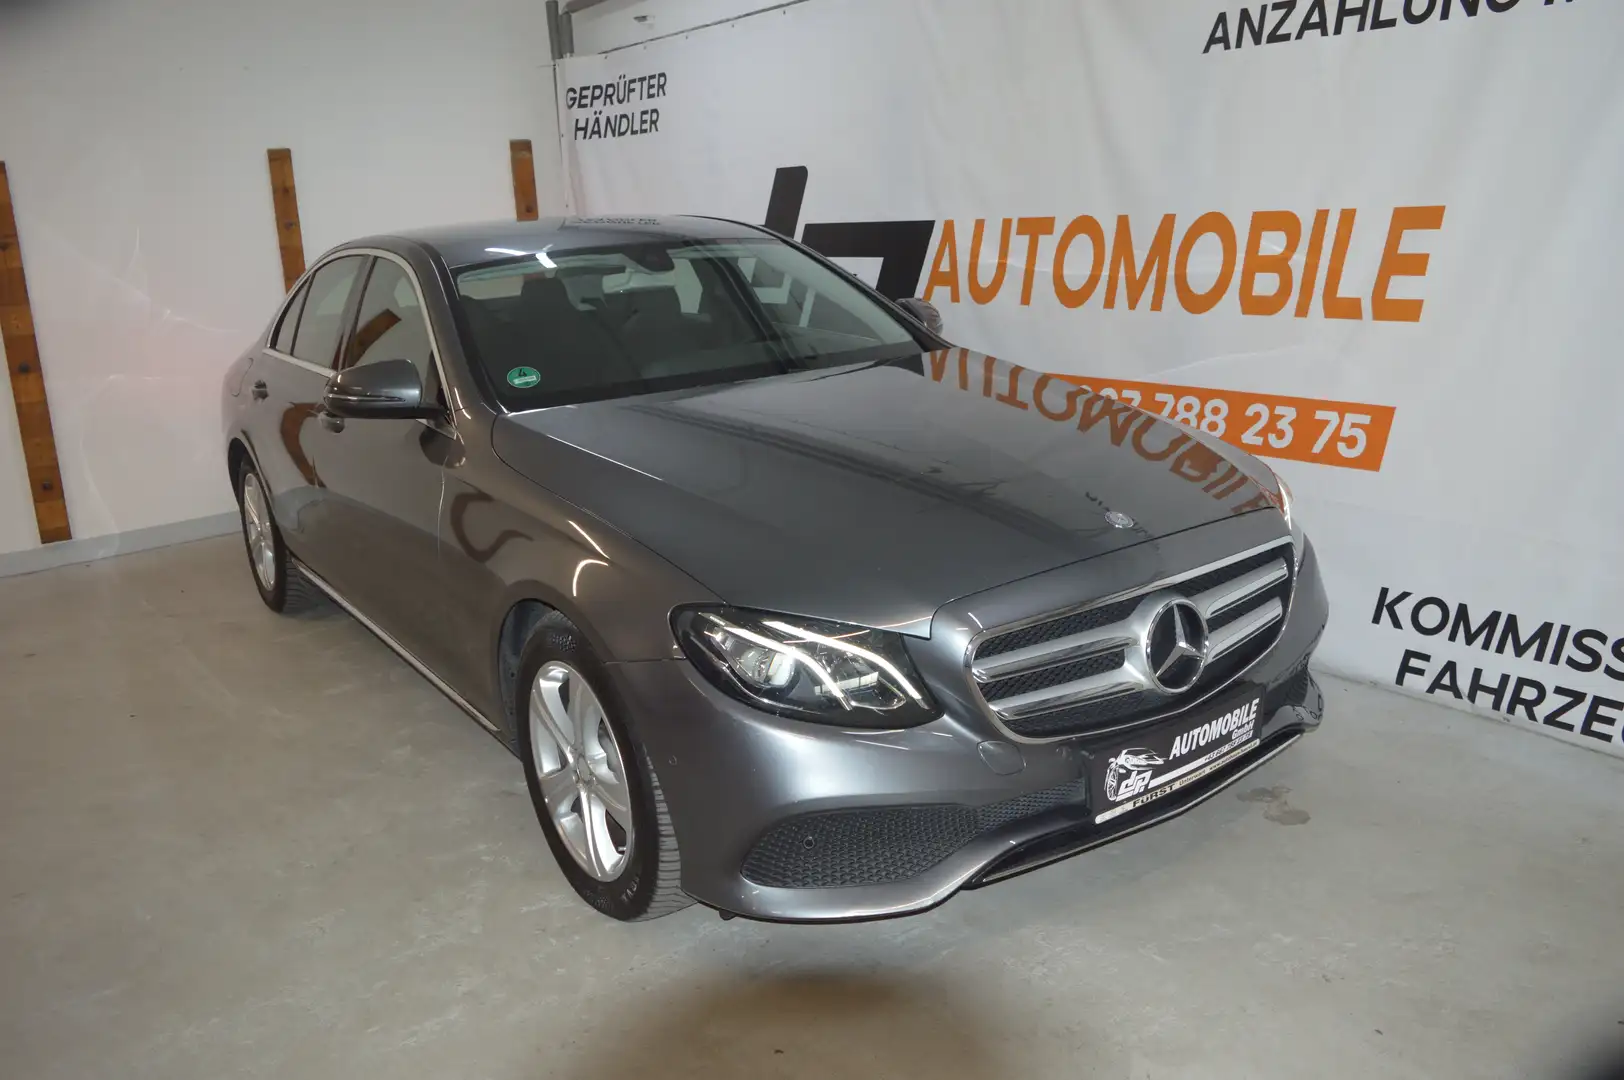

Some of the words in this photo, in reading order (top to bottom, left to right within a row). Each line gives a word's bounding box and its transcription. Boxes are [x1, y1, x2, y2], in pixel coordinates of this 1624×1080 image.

[566, 72, 668, 110] GEPRÜFTER
[574, 108, 660, 141] HÄNDLER
[921, 206, 1446, 322] AUTOMOBILE
[1154, 393, 1229, 438] 788
[1241, 403, 1297, 449] 23
[1311, 410, 1371, 459] 75
[1395, 648, 1624, 744] FAHRZE
[1169, 698, 1260, 760] AUTOMOBILE
[1231, 719, 1255, 740] GmbH
